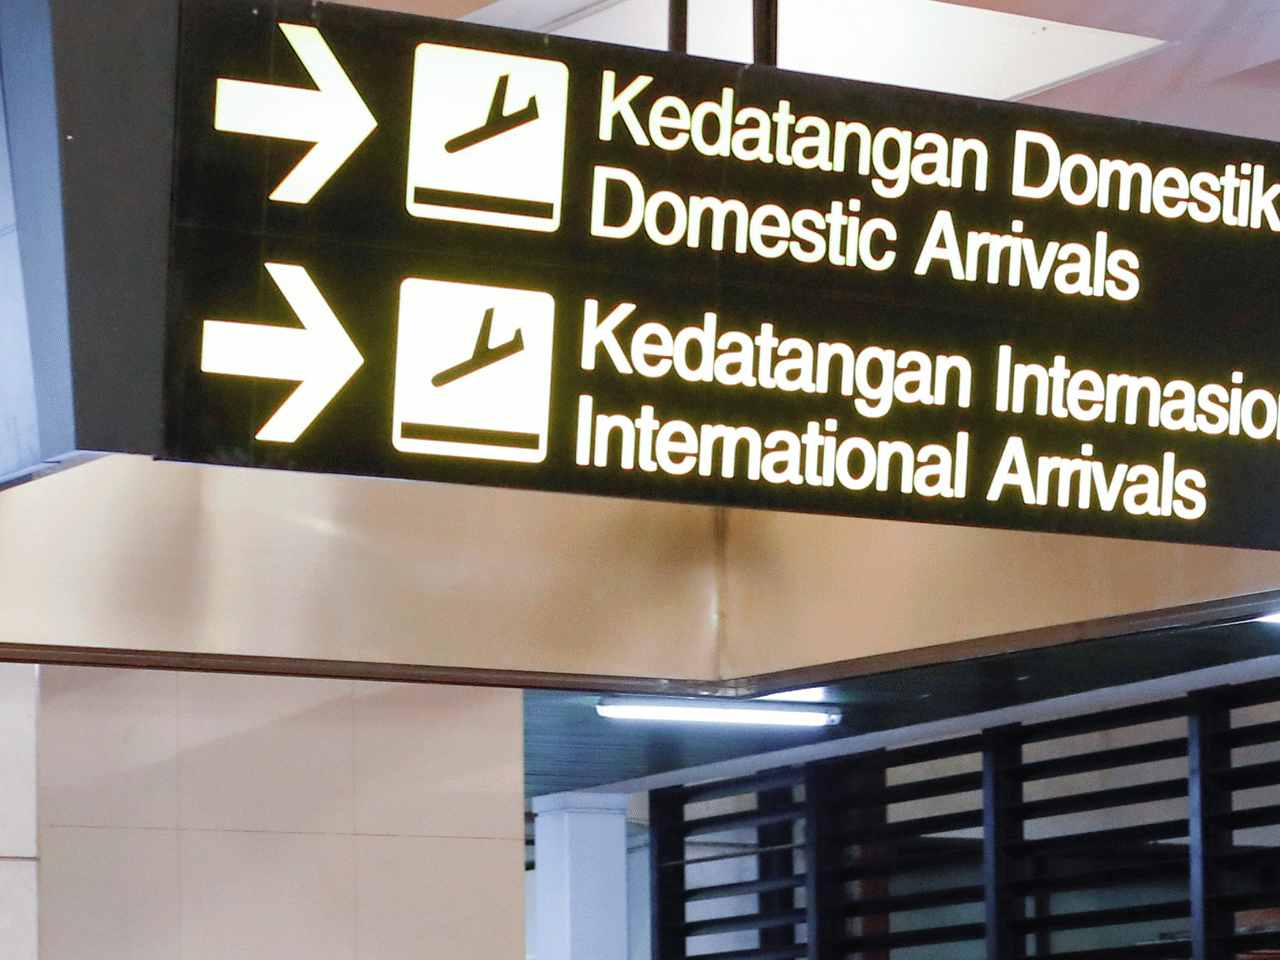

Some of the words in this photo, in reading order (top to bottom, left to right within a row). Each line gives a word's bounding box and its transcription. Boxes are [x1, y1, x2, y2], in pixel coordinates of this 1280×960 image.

[598, 70, 988, 199] Kedatangan
[591, 165, 897, 271] Domestic
[914, 210, 1141, 301] Arrivals
[581, 299, 972, 418] Kedatangan
[576, 394, 969, 498] International
[986, 436, 1207, 520] Arrivals
